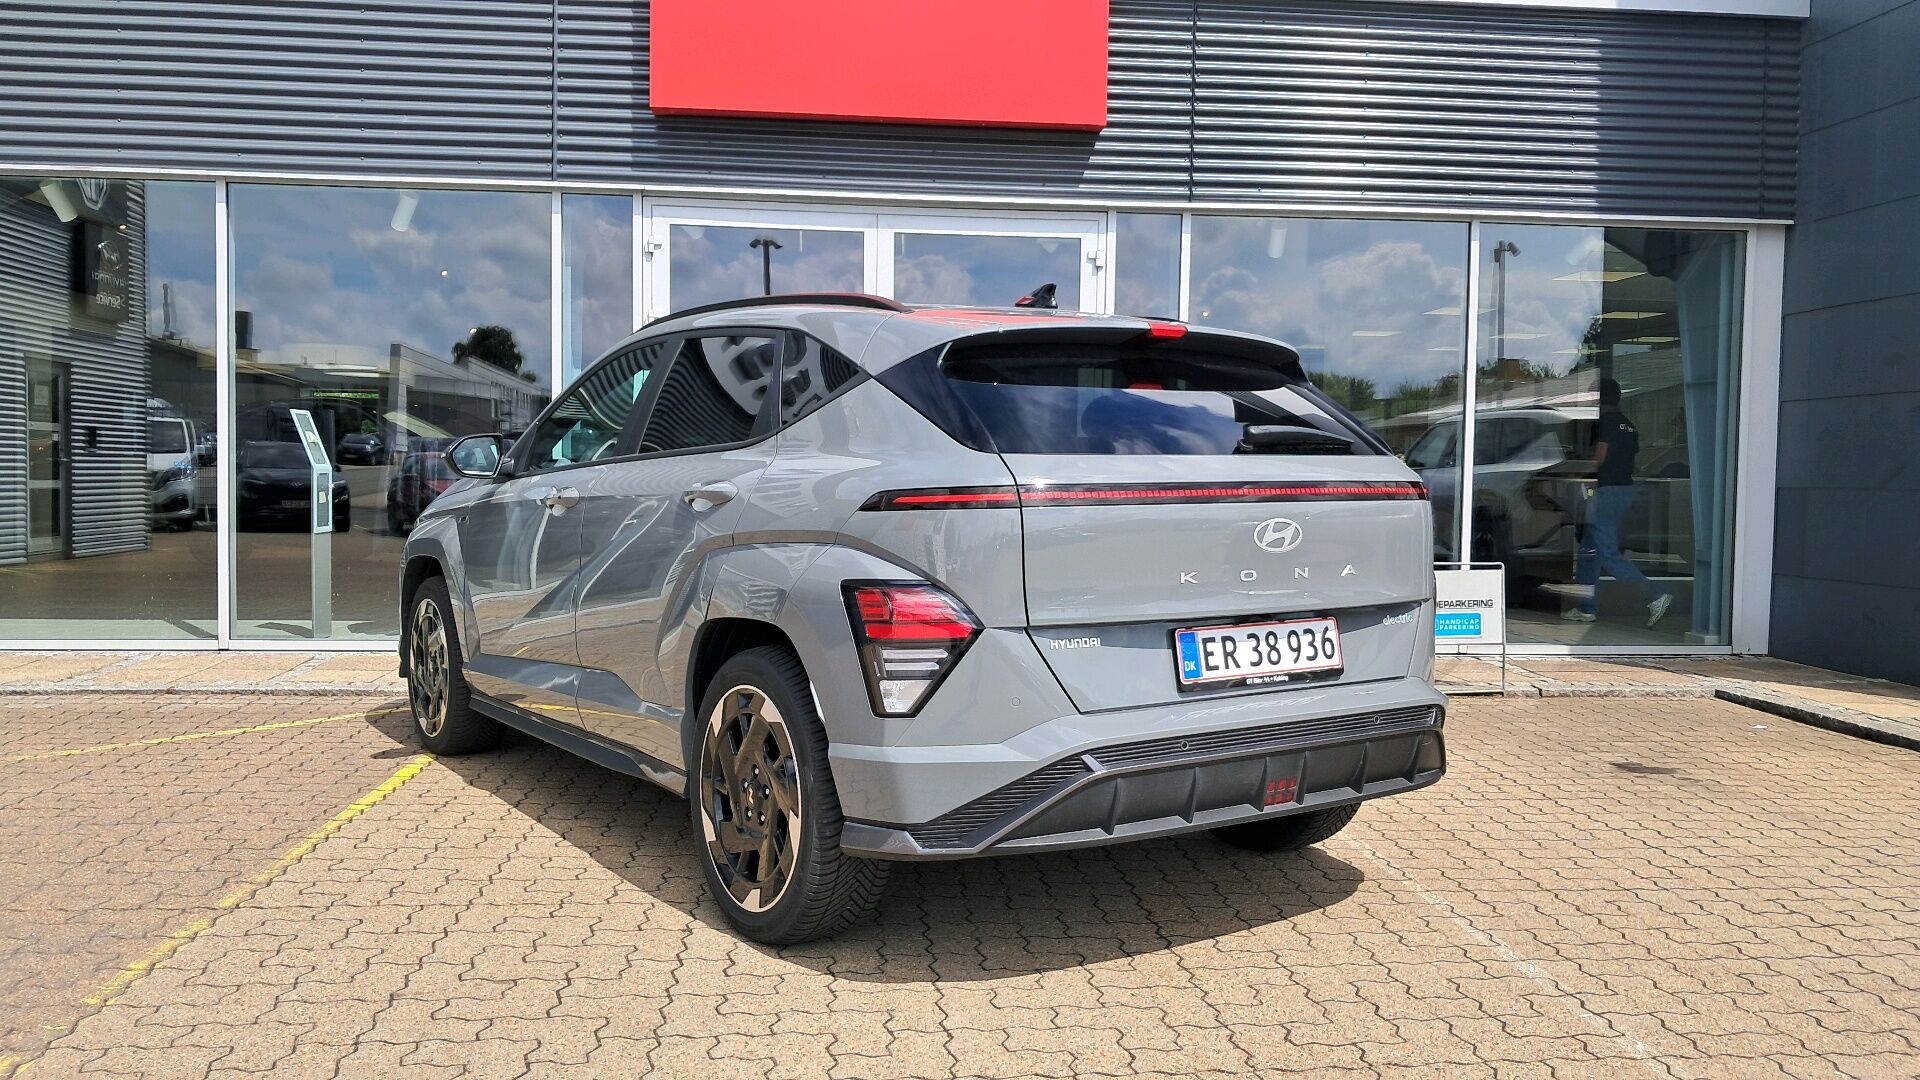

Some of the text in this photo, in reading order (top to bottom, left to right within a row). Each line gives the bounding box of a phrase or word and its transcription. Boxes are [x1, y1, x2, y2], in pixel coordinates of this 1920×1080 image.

[1180, 564, 1357, 584] KONA
[1382, 612, 1414, 625] electric
[1050, 637, 1101, 650] HYUNDAI
[1201, 625, 1335, 672] ER 38 936
[1184, 660, 1197, 672] DK
